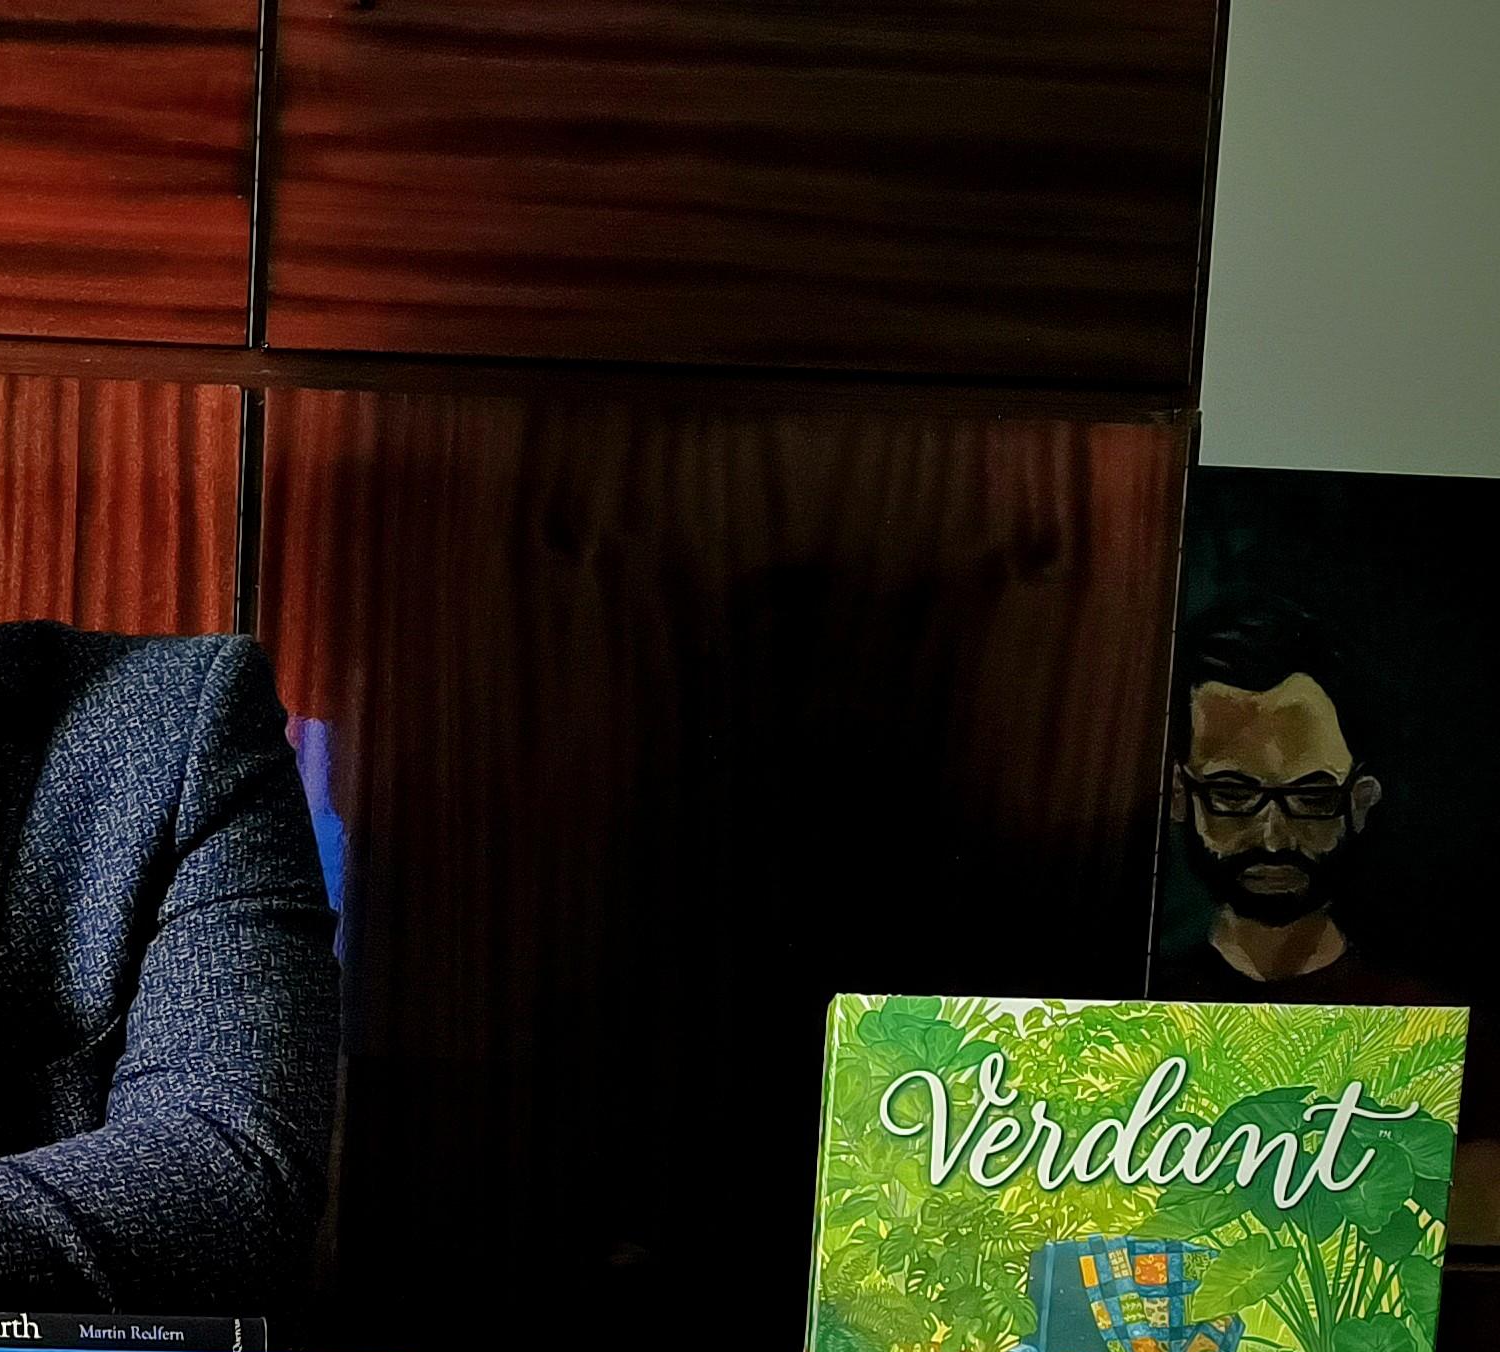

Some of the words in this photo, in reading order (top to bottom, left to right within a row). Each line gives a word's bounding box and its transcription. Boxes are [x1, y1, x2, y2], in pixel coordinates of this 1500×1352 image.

[880, 1052, 1418, 1208] Verdant
[79, 1324, 126, 1340] Martin
[131, 1325, 184, 1342] Redfern
